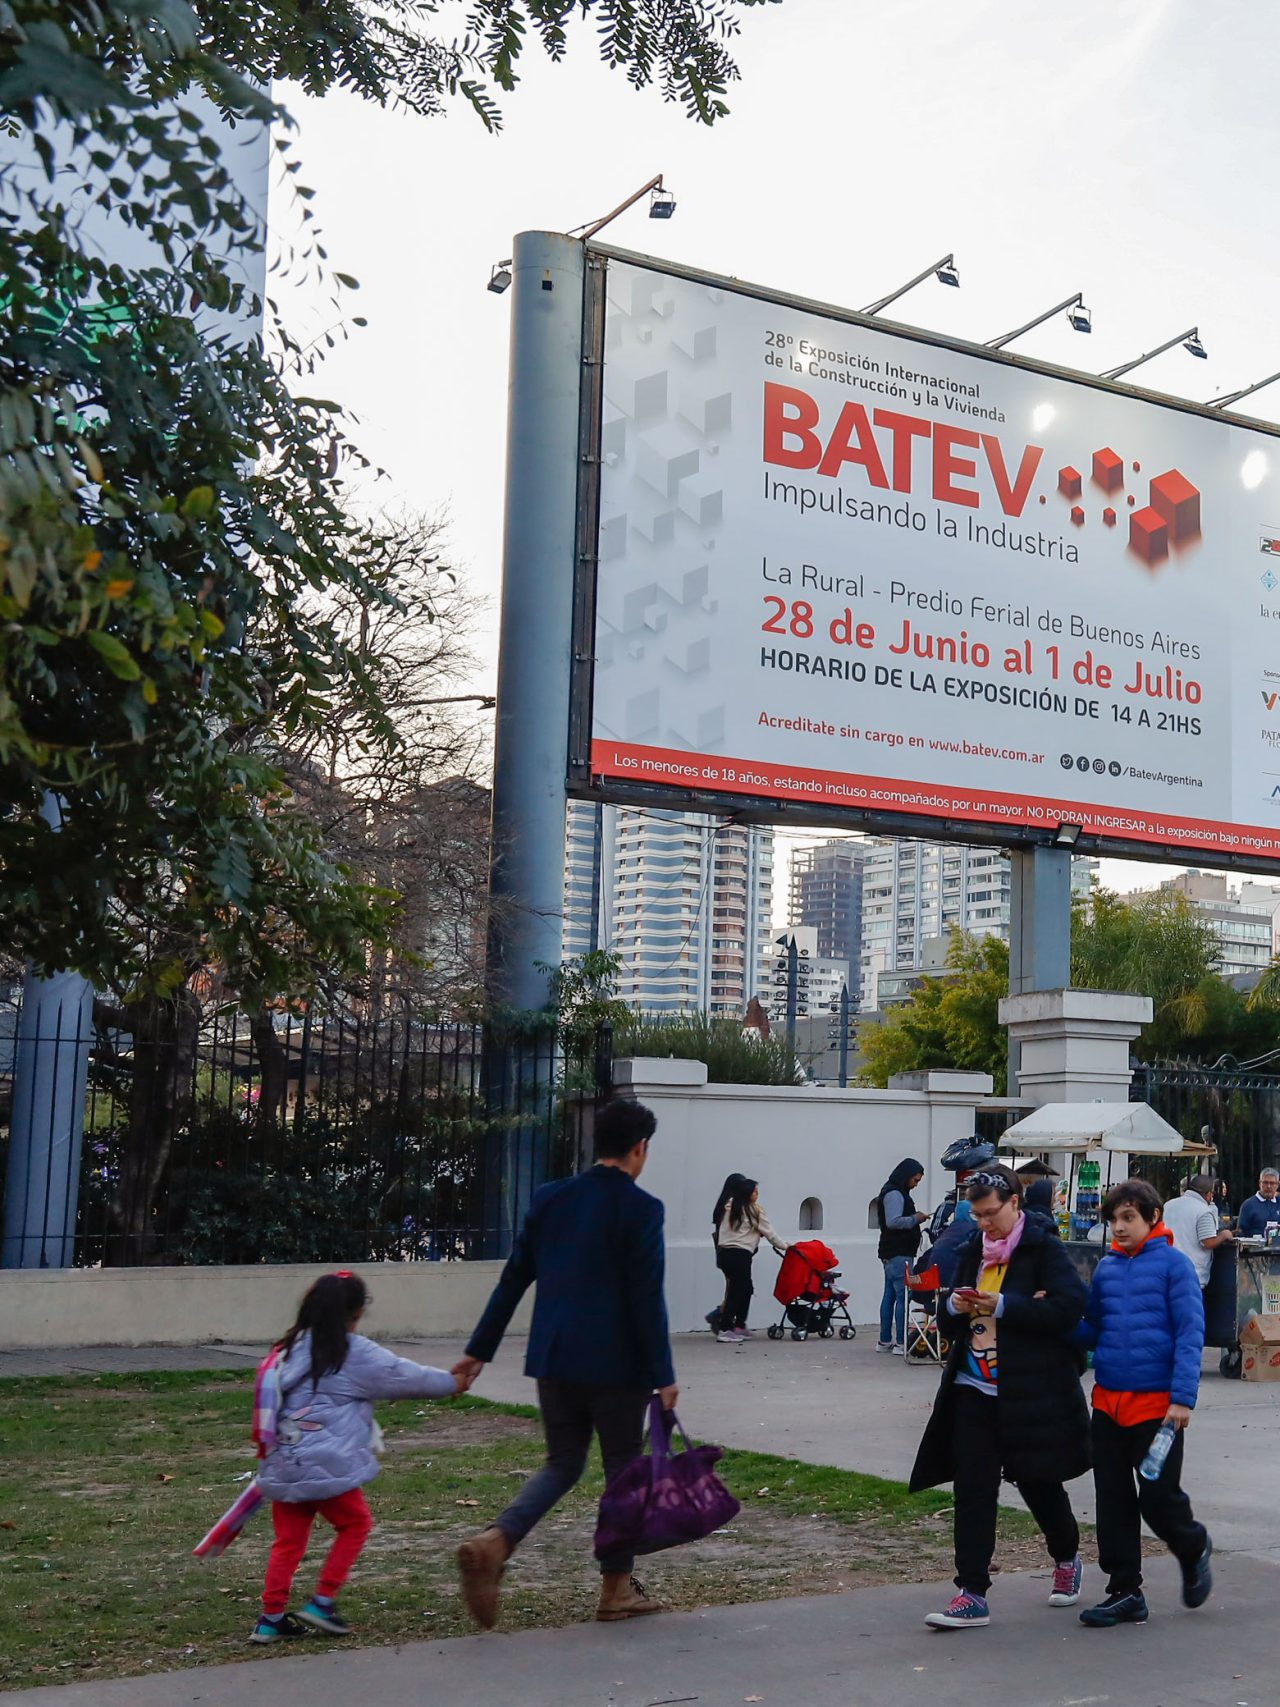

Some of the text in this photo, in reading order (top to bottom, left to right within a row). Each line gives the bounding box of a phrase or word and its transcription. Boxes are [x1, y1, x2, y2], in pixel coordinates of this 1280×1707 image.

[764, 351, 1006, 423] de la Construcción y la Vivienda
[799, 340, 880, 374] Exposición
[886, 362, 980, 398] Internacional
[763, 380, 1044, 518] BATEV
[764, 471, 1078, 563] Impulsando la Industria
[761, 595, 1202, 704] 28 de Junio al 1 de Julio
[762, 557, 1200, 659] La Rural Predio Ferial de Buenos Aires
[1260, 604, 1270, 617] la
[761, 647, 1202, 735] HORARIO DE LA EXPOSICIÓN DE 14 A 21HS
[758, 711, 1045, 764] Acreditate sin cargo en www.batev.com.ar
[1122, 766, 1203, 788] /BatevArgentina
[614, 753, 638, 768] Los
[641, 758, 699, 777] menores
[702, 766, 718, 779] de
[721, 768, 735, 781] 18
[739, 771, 770, 787] años,
[774, 775, 822, 793] estando
[825, 781, 868, 798] incluso
[870, 789, 949, 809] acompañados
[952, 800, 970, 813] por
[973, 801, 987, 812] un
[989, 804, 1024, 819] mayor.
[1027, 807, 1044, 819] NO
[1046, 808, 1092, 825] PODRAN
[1094, 815, 1146, 832] INGRESAR
[1148, 824, 1154, 833] a
[1156, 822, 1165, 835] la
[1167, 826, 1218, 844] exposición
[1219, 831, 1240, 847] bajo
[1241, 834, 1273, 851] ningún
